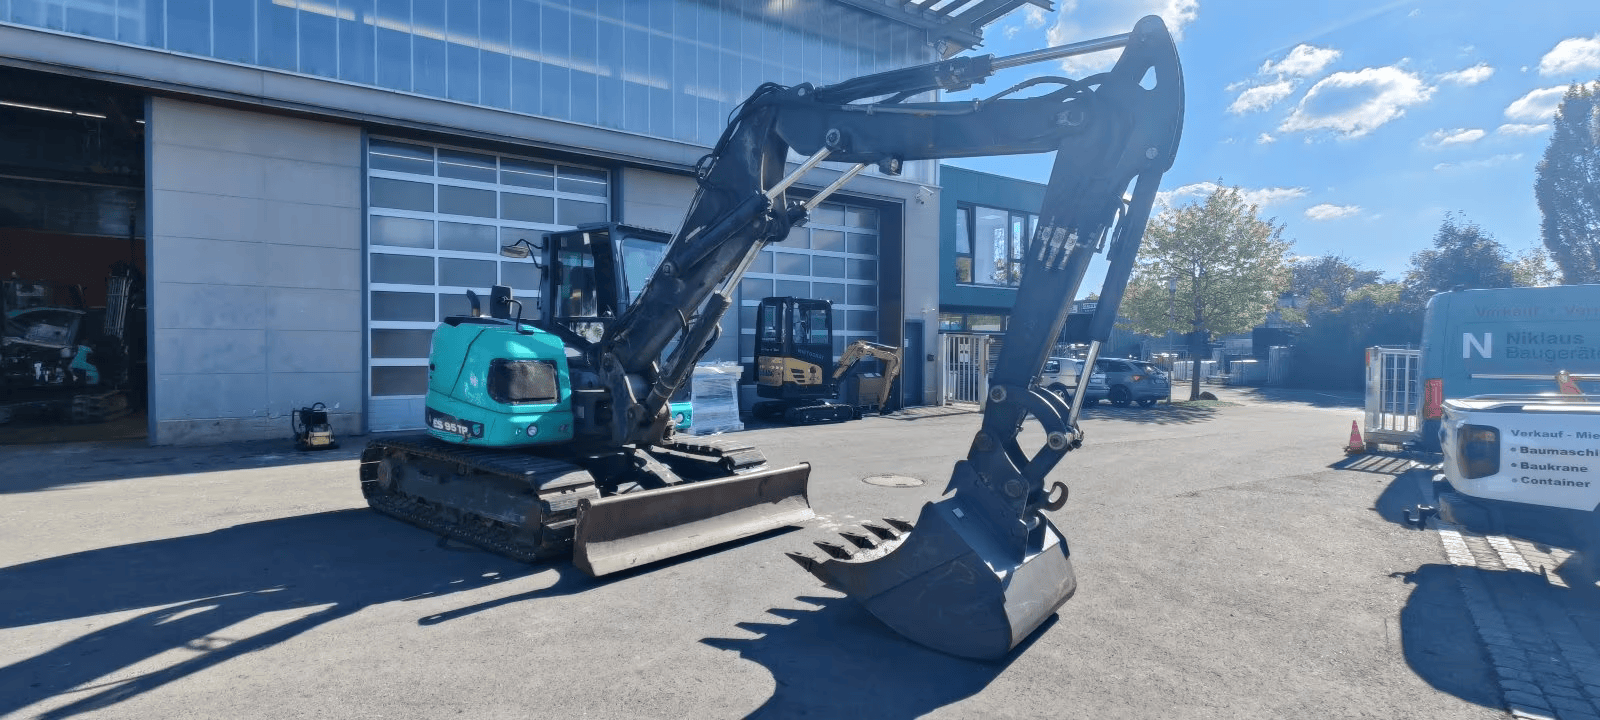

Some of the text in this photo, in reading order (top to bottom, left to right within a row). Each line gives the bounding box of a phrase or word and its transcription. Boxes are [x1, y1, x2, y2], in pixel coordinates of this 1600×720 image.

[1506, 332, 1585, 345] Niklaus
[1462, 332, 1492, 359] N
[433, 418, 444, 430] ES
[445, 422, 457, 432] 95
[1510, 429, 1564, 438] Verkauf
[1520, 462, 1589, 473] Baukrane
[1520, 476, 1591, 488] Container
